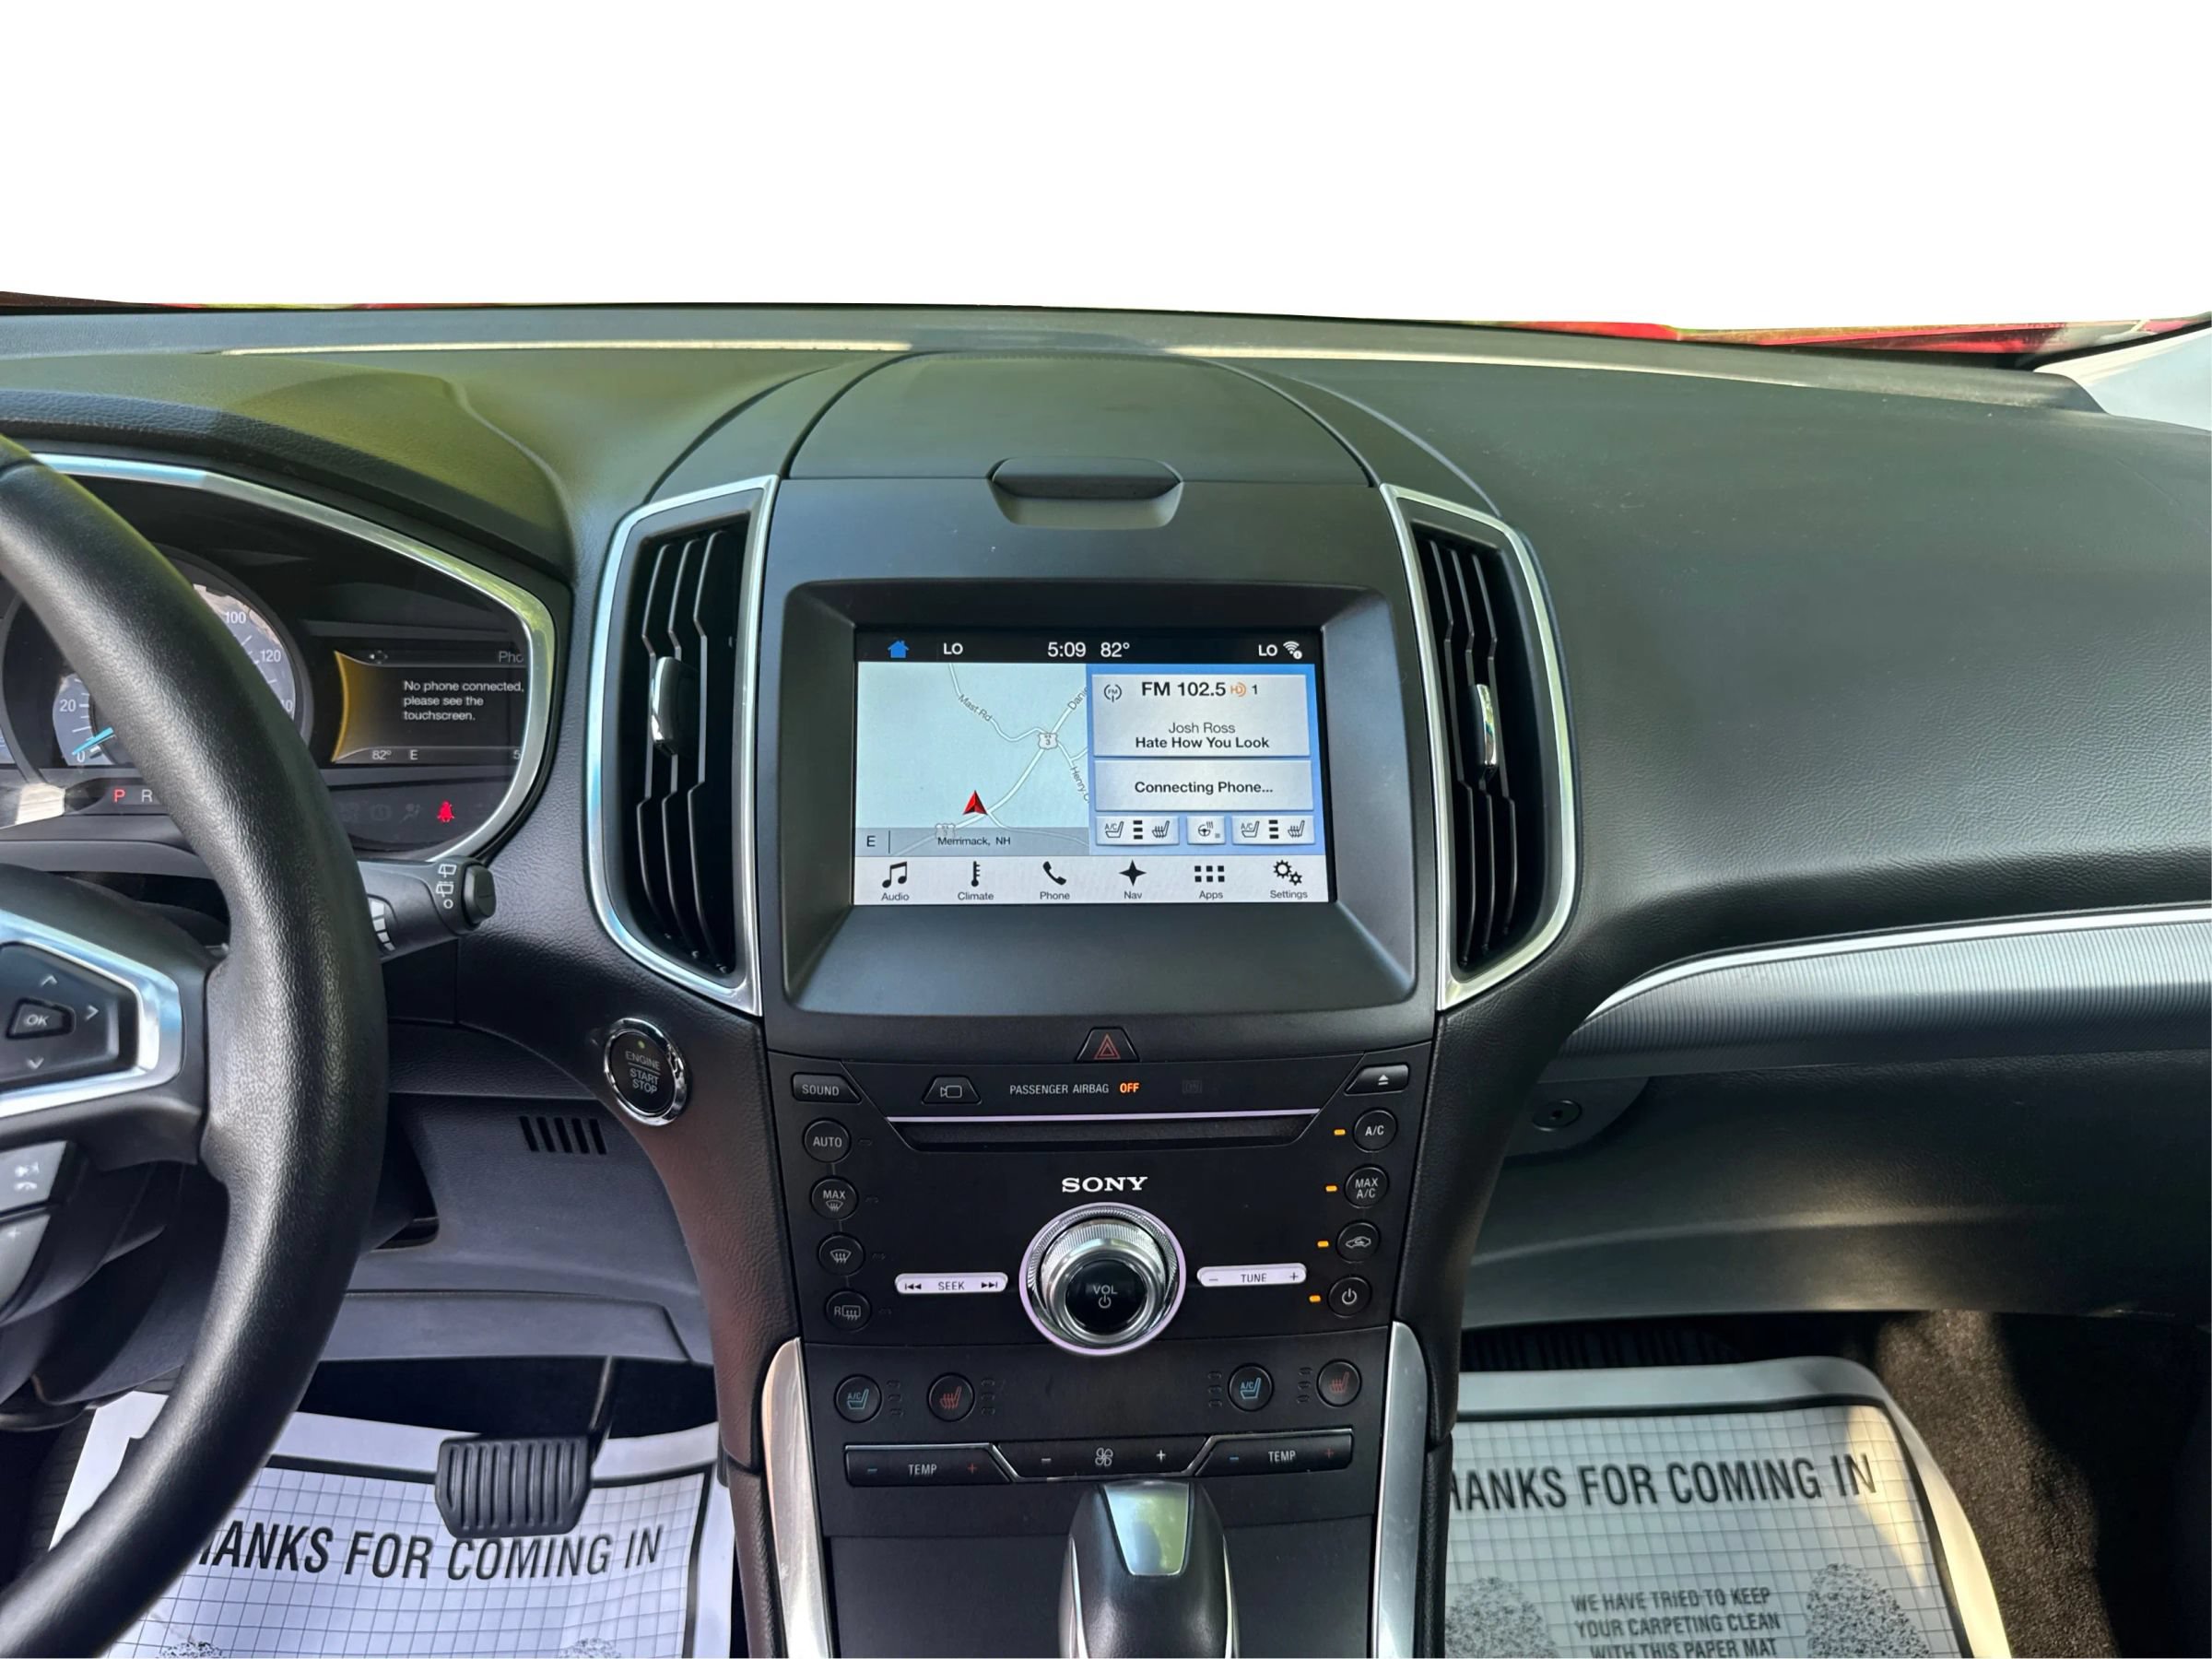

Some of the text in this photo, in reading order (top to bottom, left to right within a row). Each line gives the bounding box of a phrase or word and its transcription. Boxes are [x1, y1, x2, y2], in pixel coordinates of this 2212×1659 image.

[225, 611, 247, 624] 100
[943, 642, 963, 655] LO
[1047, 641, 1130, 657] 5:09 82°
[1258, 644, 1278, 657] LO
[259, 649, 281, 663] 120
[404, 680, 524, 694] No phone connected,
[1141, 681, 1171, 696] FM
[1177, 681, 1226, 697] 102.5
[1252, 685, 1258, 695] 1
[59, 699, 76, 712] 20
[404, 696, 484, 708] please see the
[959, 693, 993, 722] Mast Rd
[403, 710, 476, 722] touchscreen.
[1168, 722, 1236, 735] Josh Ross
[1135, 736, 1270, 748] Hate How You Look
[76, 750, 86, 763] 0
[410, 749, 418, 760] E
[1070, 765, 1087, 793] Henry
[1134, 781, 1274, 796] Connecting Phone...
[113, 788, 153, 803] P R
[866, 835, 876, 847] E
[937, 836, 1011, 846] Merrimack, NH
[880, 891, 910, 901] Audio
[957, 891, 994, 901] Climate
[1040, 890, 1070, 900] Phone
[1124, 890, 1143, 900] Nav
[1198, 890, 1224, 901] Apps
[1269, 889, 1308, 900] Settings
[25, 1014, 49, 1026] OK
[625, 1051, 661, 1071] ENGINE
[629, 1067, 659, 1086] START
[632, 1077, 658, 1095] STOP
[801, 1083, 840, 1097] SOUND
[1009, 1083, 1069, 1095] PASSENGER
[1072, 1083, 1110, 1095] AIRBAG
[1119, 1081, 1141, 1094] OFF
[1365, 1124, 1385, 1137] A/C
[812, 1135, 842, 1148] AUTO
[1061, 1175, 1148, 1194] SONY
[1355, 1177, 1379, 1190] MAX
[822, 1189, 846, 1201] MAX
[1356, 1188, 1377, 1200] A/C
[1241, 1272, 1267, 1284] TUNE
[937, 1281, 965, 1291] SEEK
[1092, 1285, 1118, 1296] VOL
[1240, 1381, 1254, 1390] A/C
[847, 1391, 862, 1401] A/C
[1267, 1449, 1297, 1464] TEMP
[908, 1464, 937, 1477] TEMP
[1576, 1463, 1658, 1507] FOR
[1666, 1455, 1824, 1505] COMING
[1829, 1453, 1877, 1498] IN
[198, 1519, 665, 1581] ANKS FOR COMING IN
[1571, 1586, 1771, 1613] WE HAVE TRIED TO KEEP
[1574, 1612, 1782, 1639] YOUR CARPETING CLEAN
[1590, 1638, 1778, 1659] WITH THIS PAPER MAT
